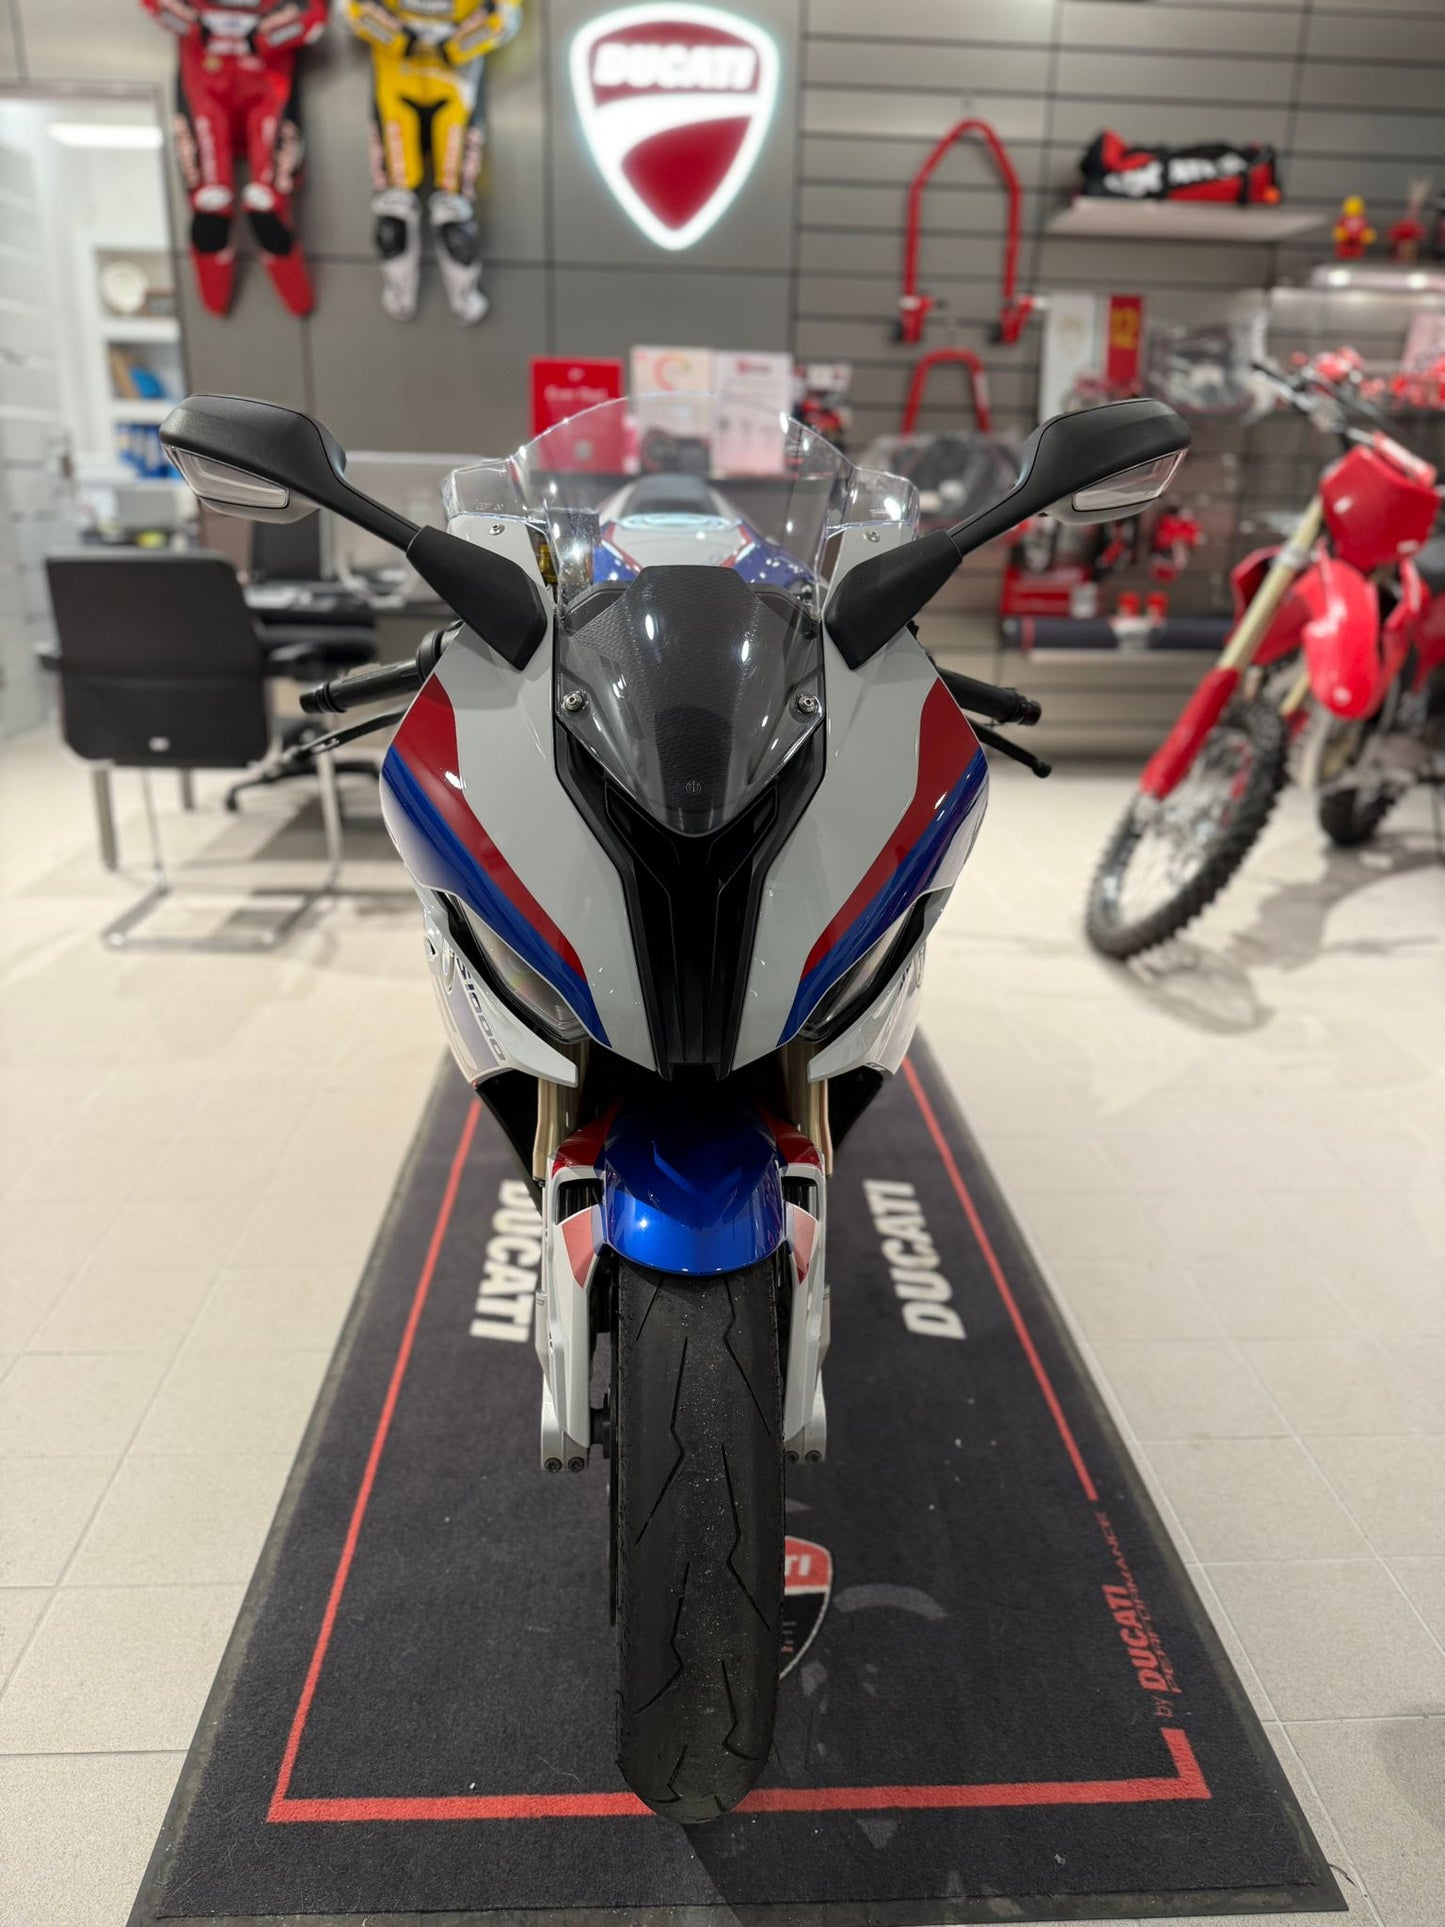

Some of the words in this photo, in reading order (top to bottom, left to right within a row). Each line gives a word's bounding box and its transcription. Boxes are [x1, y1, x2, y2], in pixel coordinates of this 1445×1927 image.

[593, 43, 756, 90] DUCATI
[469, 1179, 542, 1343] DUCATI
[862, 1179, 967, 1339] DUCATI
[1102, 1585, 1169, 1692] DUCATI
